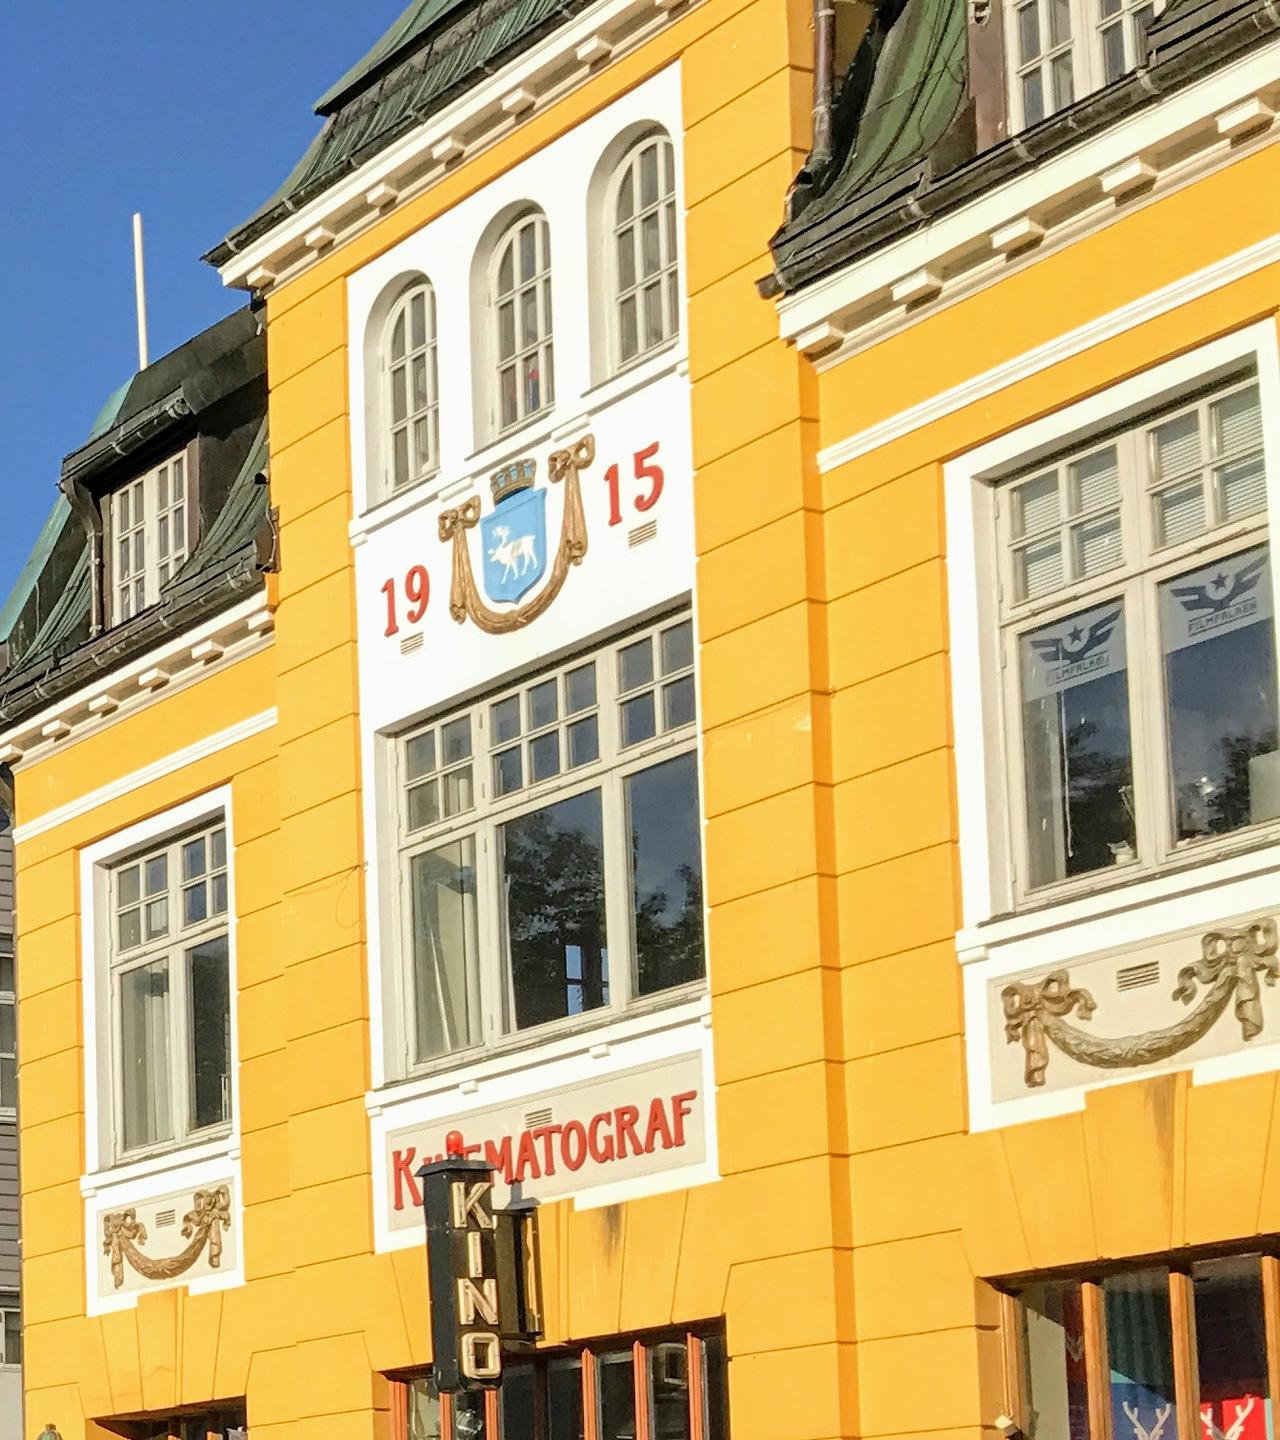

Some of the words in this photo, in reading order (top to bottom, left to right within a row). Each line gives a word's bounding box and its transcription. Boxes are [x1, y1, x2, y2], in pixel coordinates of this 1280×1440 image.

[381, 565, 430, 637] 19
[603, 441, 665, 526] 15
[392, 1090, 697, 1211] KMATOGRAF
[451, 1181, 501, 1380] KINO
